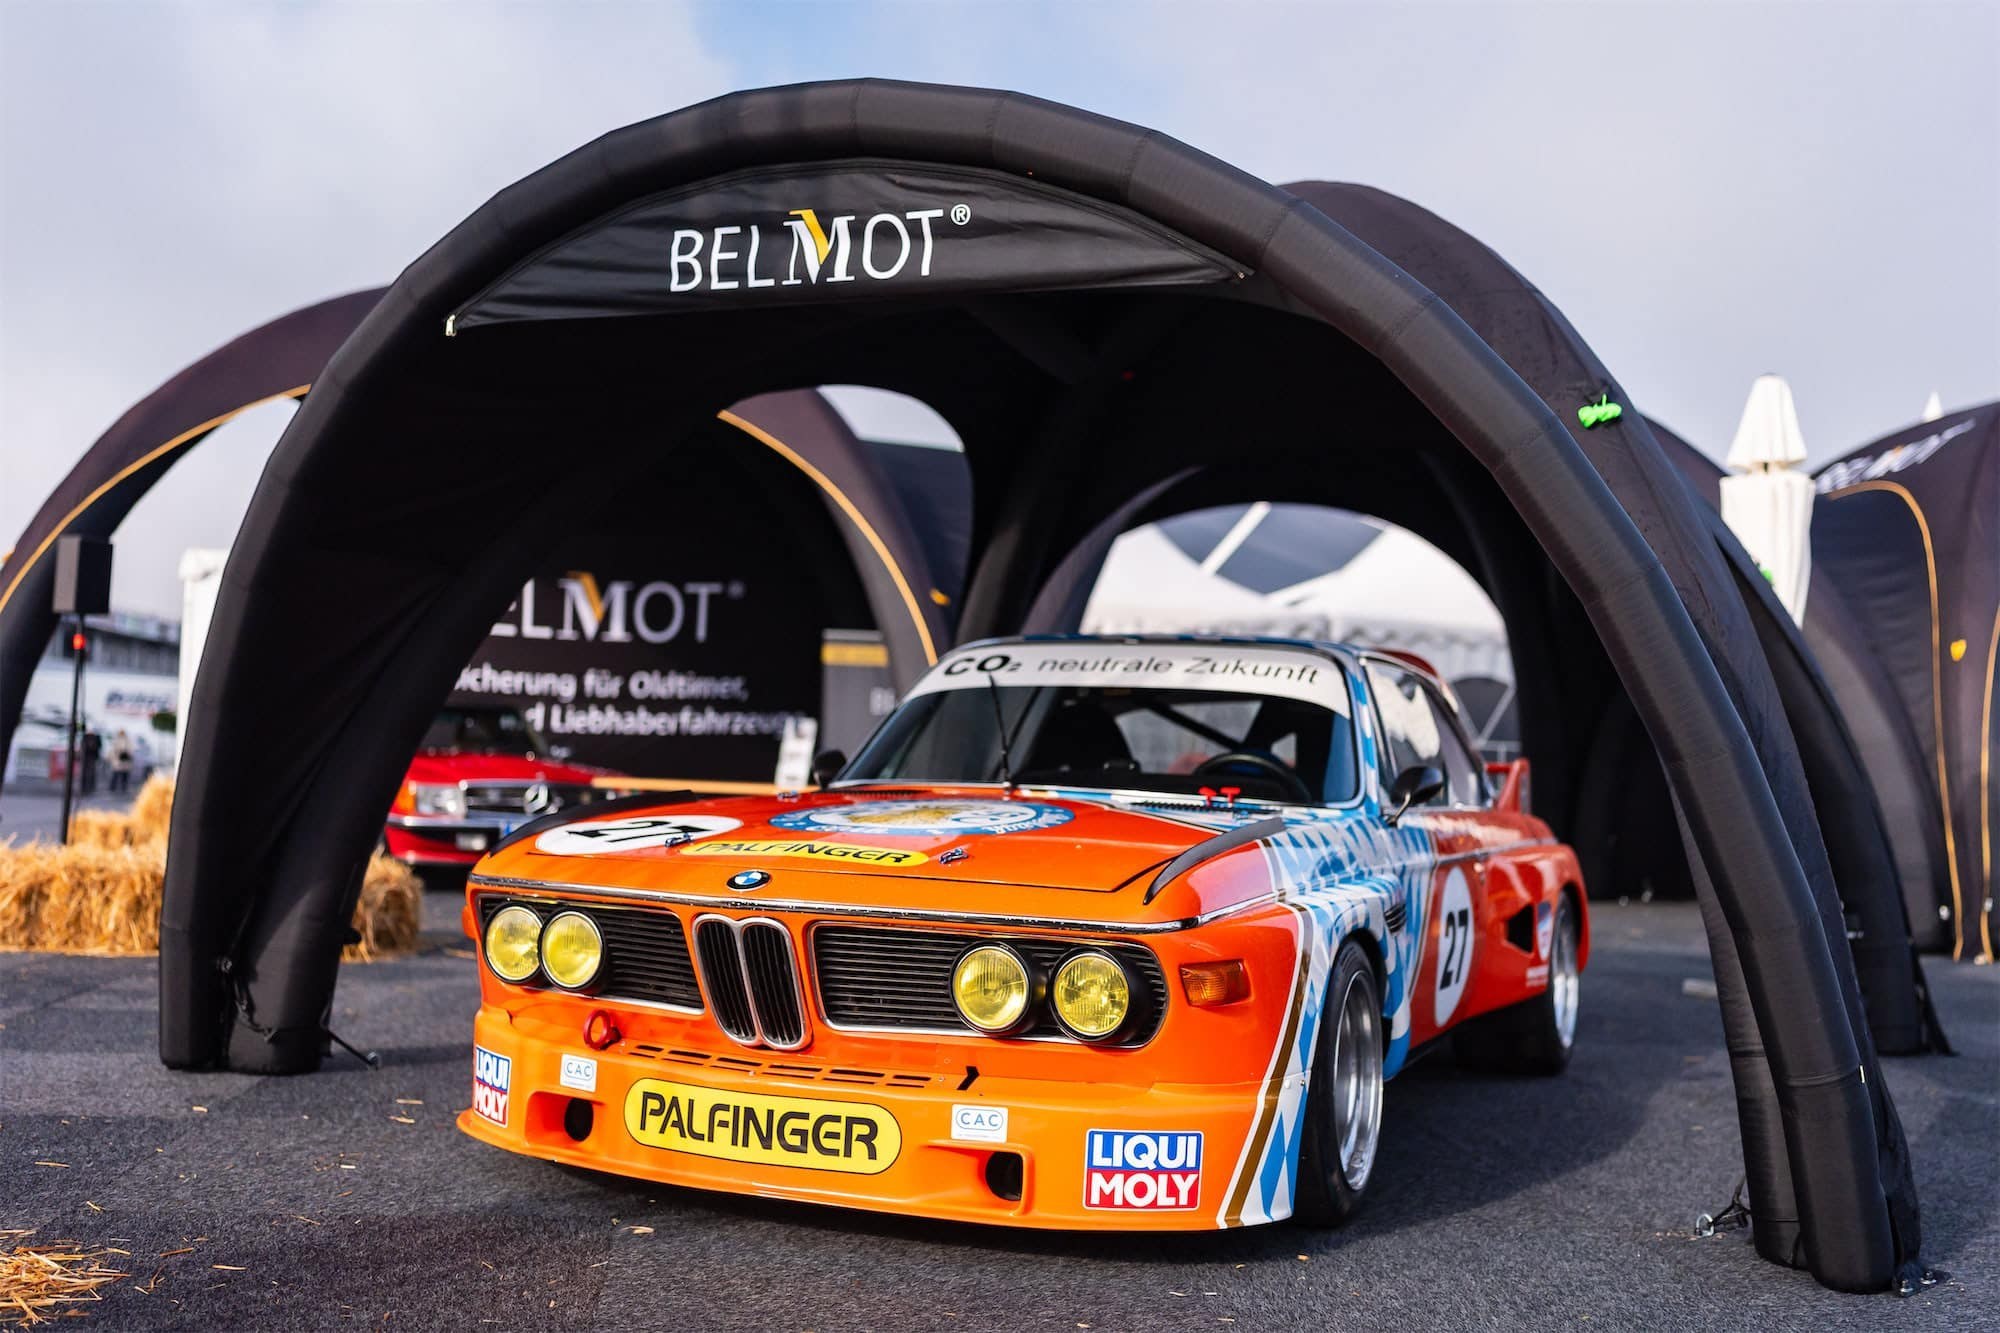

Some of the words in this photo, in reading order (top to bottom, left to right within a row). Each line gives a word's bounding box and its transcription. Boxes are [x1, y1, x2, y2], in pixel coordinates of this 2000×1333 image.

[454, 662, 577, 703] icherung
[584, 667, 623, 699] für
[1037, 656, 1174, 674] neutrale
[1185, 657, 1320, 683] Zukunft
[567, 820, 711, 843] 27
[695, 841, 912, 864] PALFINGER
[1439, 908, 1469, 990] 27
[476, 1049, 508, 1090] LIQUI
[566, 1062, 591, 1078] CAC
[475, 1083, 508, 1122] MOLY
[960, 1112, 999, 1127] CAC
[640, 1091, 879, 1160] PALFINGER
[1092, 1134, 1197, 1171] LIQUI
[1090, 1172, 1199, 1208] MOLY
